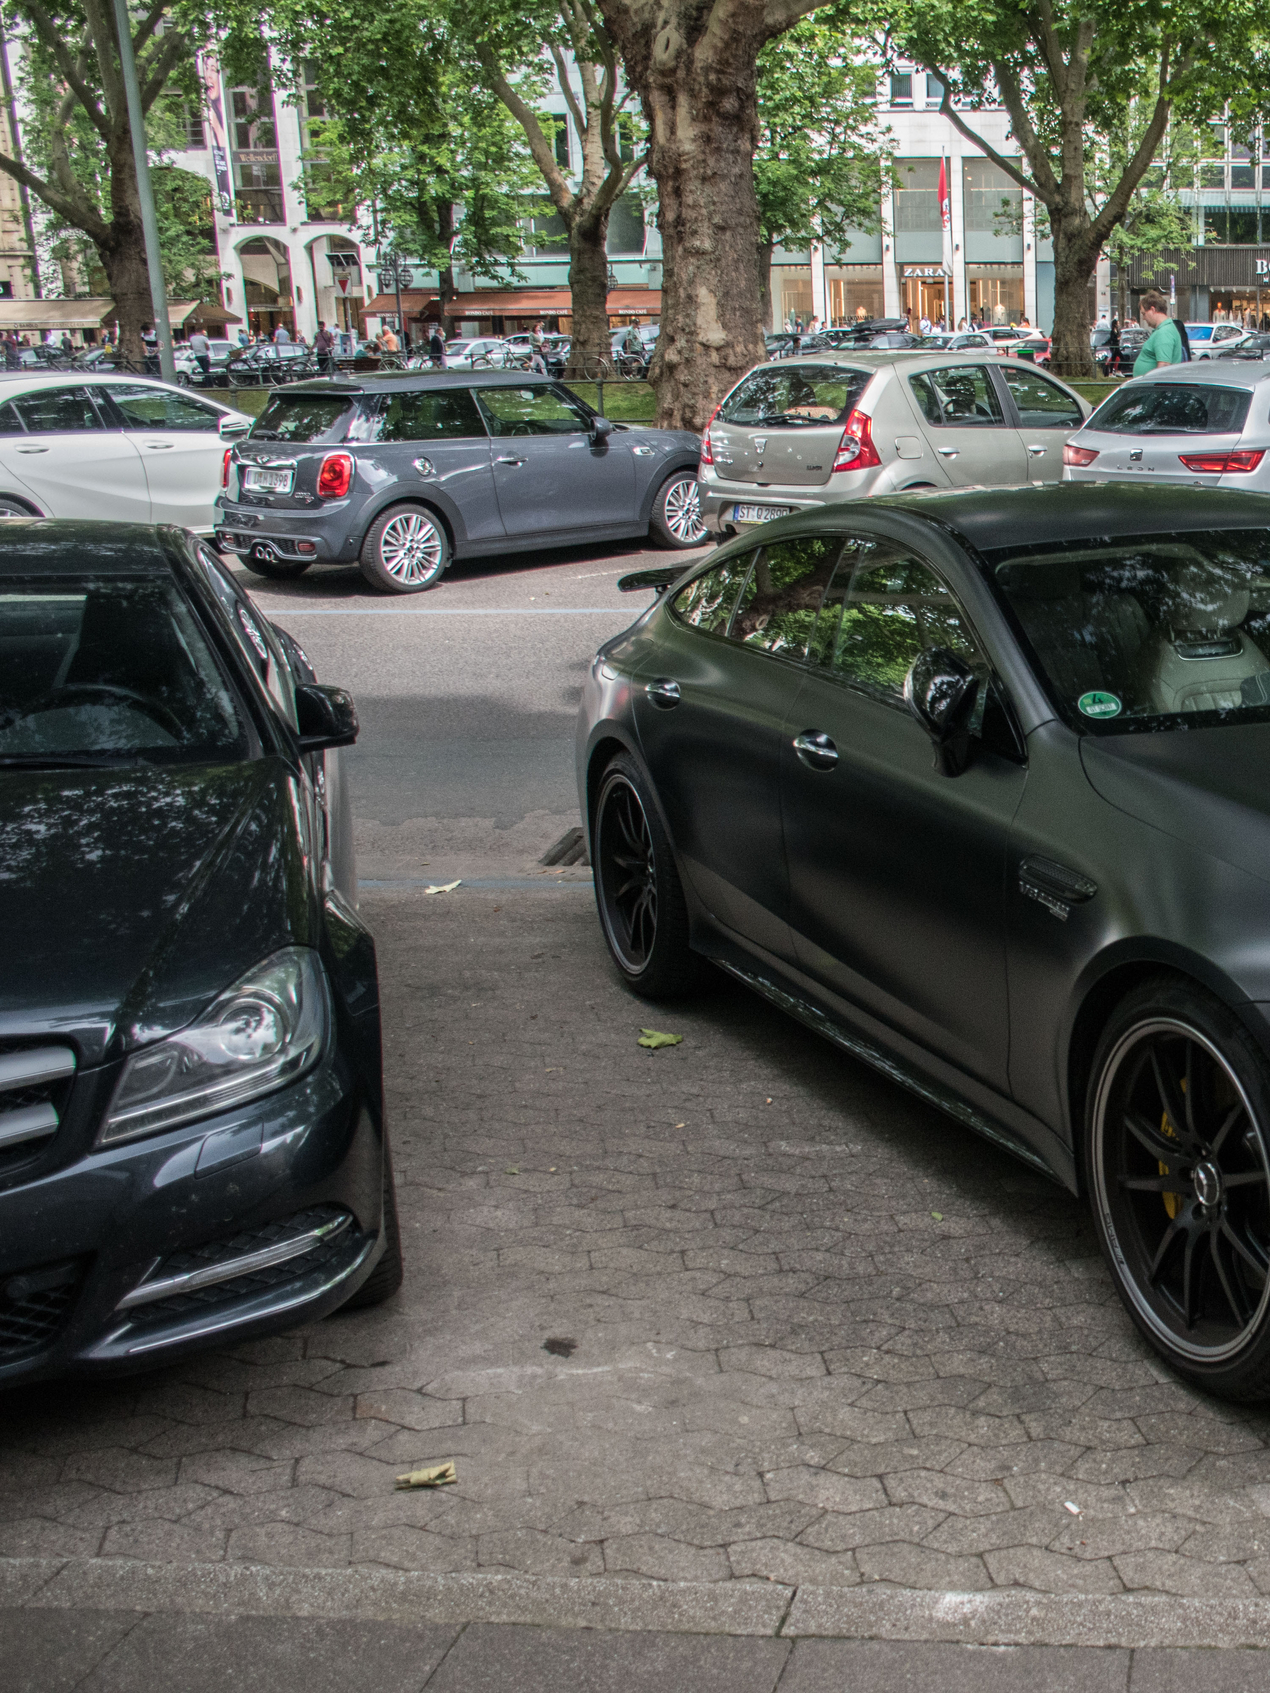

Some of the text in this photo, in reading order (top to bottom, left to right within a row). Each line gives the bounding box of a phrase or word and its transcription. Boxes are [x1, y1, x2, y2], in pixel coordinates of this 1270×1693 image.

[1116, 464, 1155, 472] LEON
[739, 507, 753, 519] ST
[756, 508, 764, 520] Q
